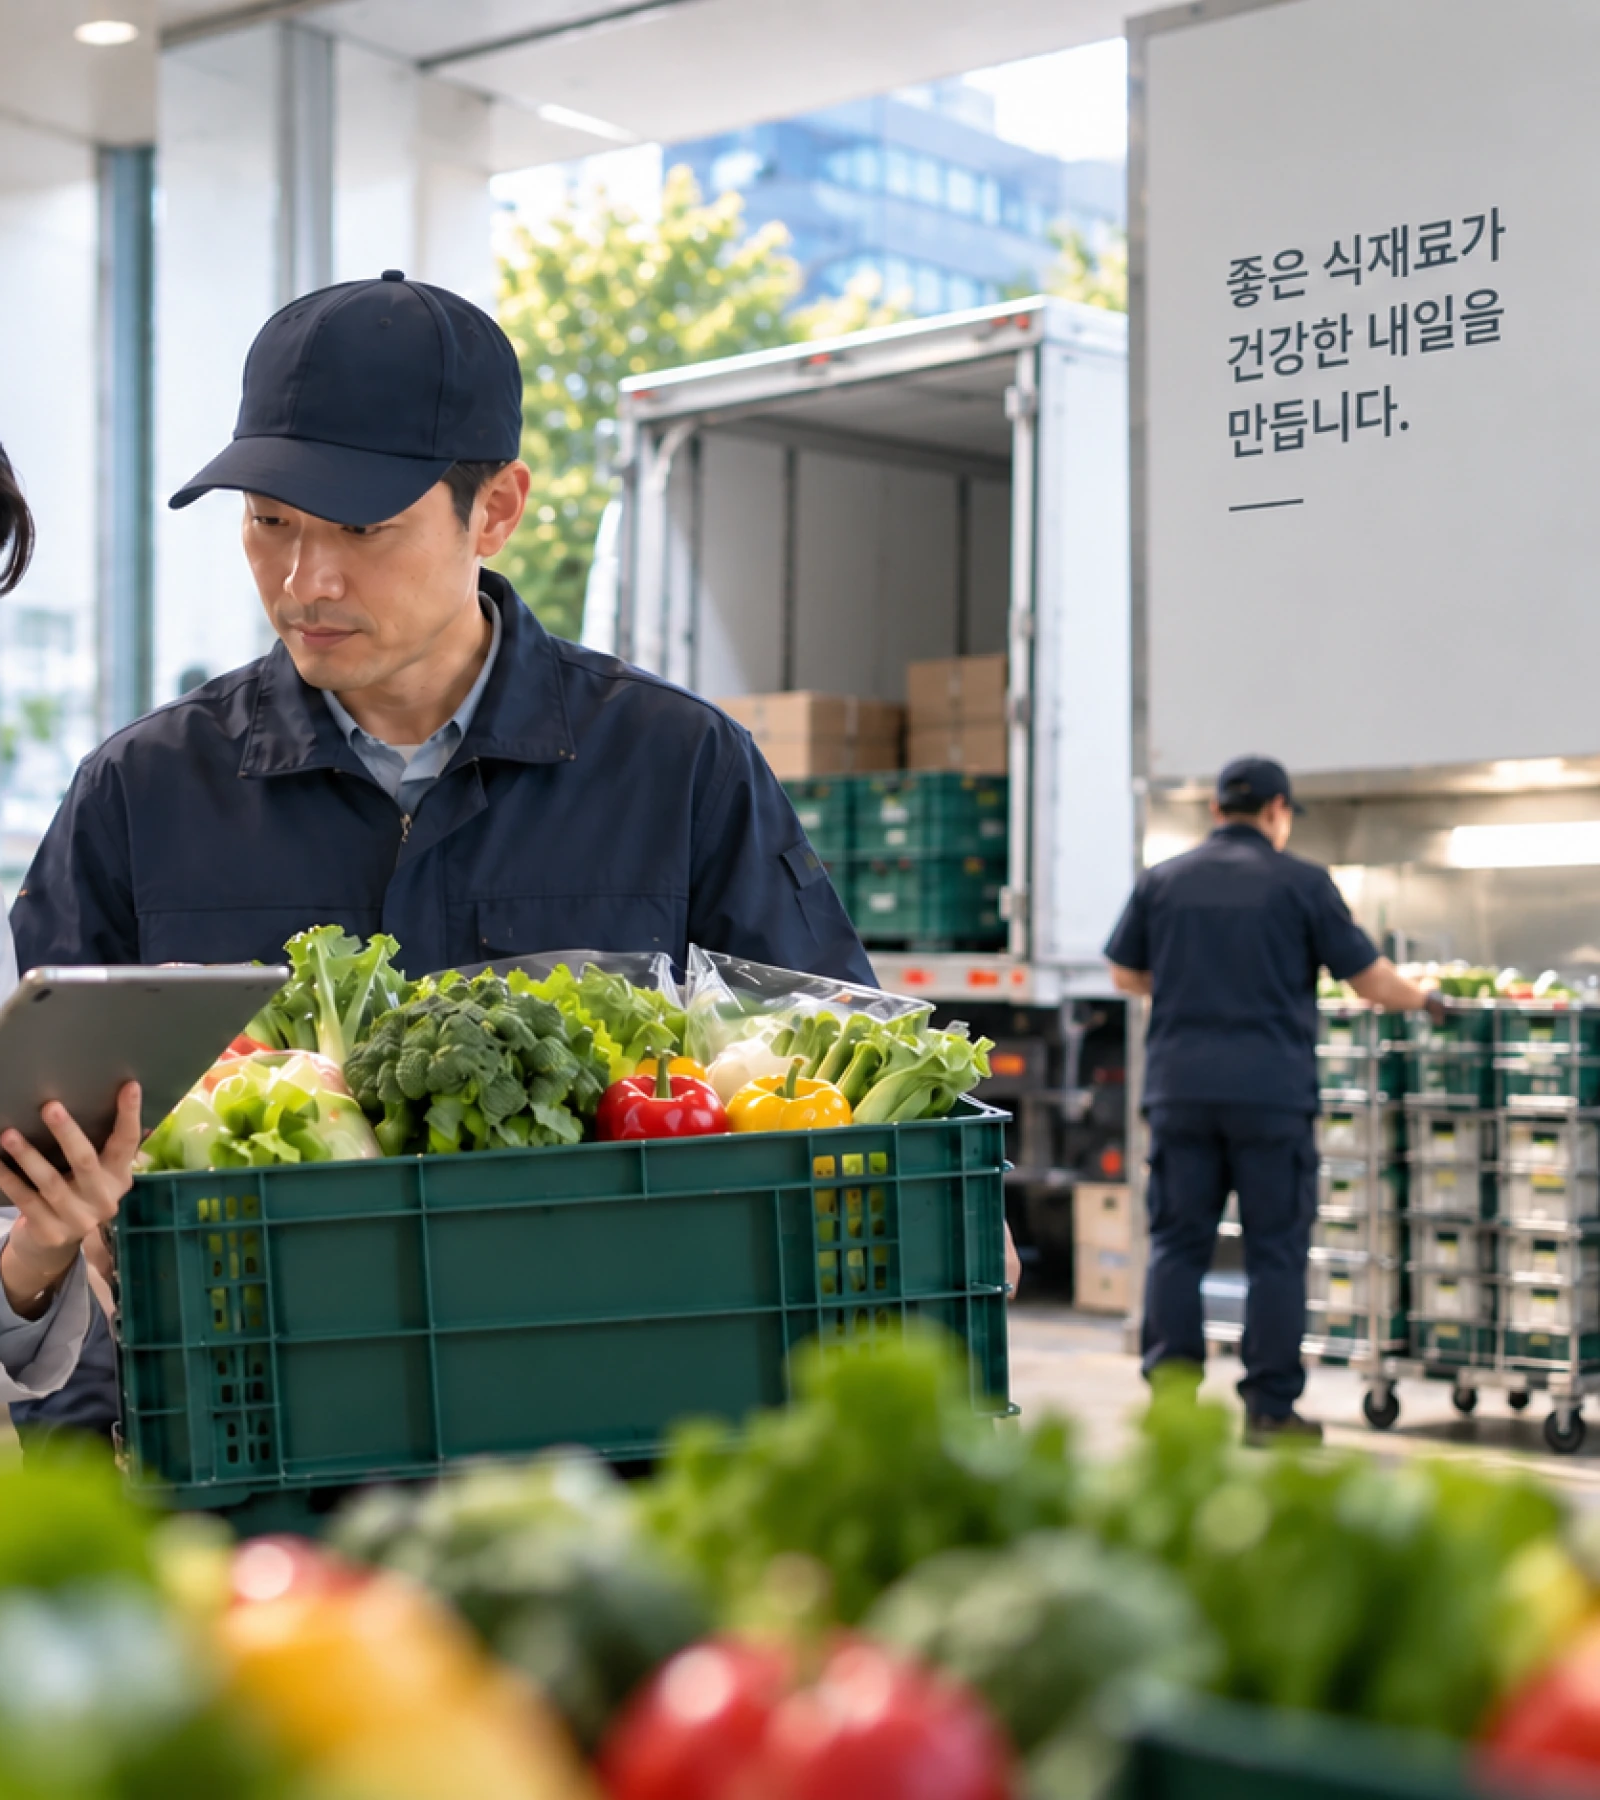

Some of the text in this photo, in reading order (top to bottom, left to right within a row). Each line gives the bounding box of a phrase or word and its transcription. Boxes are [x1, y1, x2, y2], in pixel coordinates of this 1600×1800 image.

[1226, 206, 1507, 309] 좋은 식재료가
[1227, 288, 1505, 383] 건강한 내일을
[1228, 384, 1410, 458] 만듭니다.
